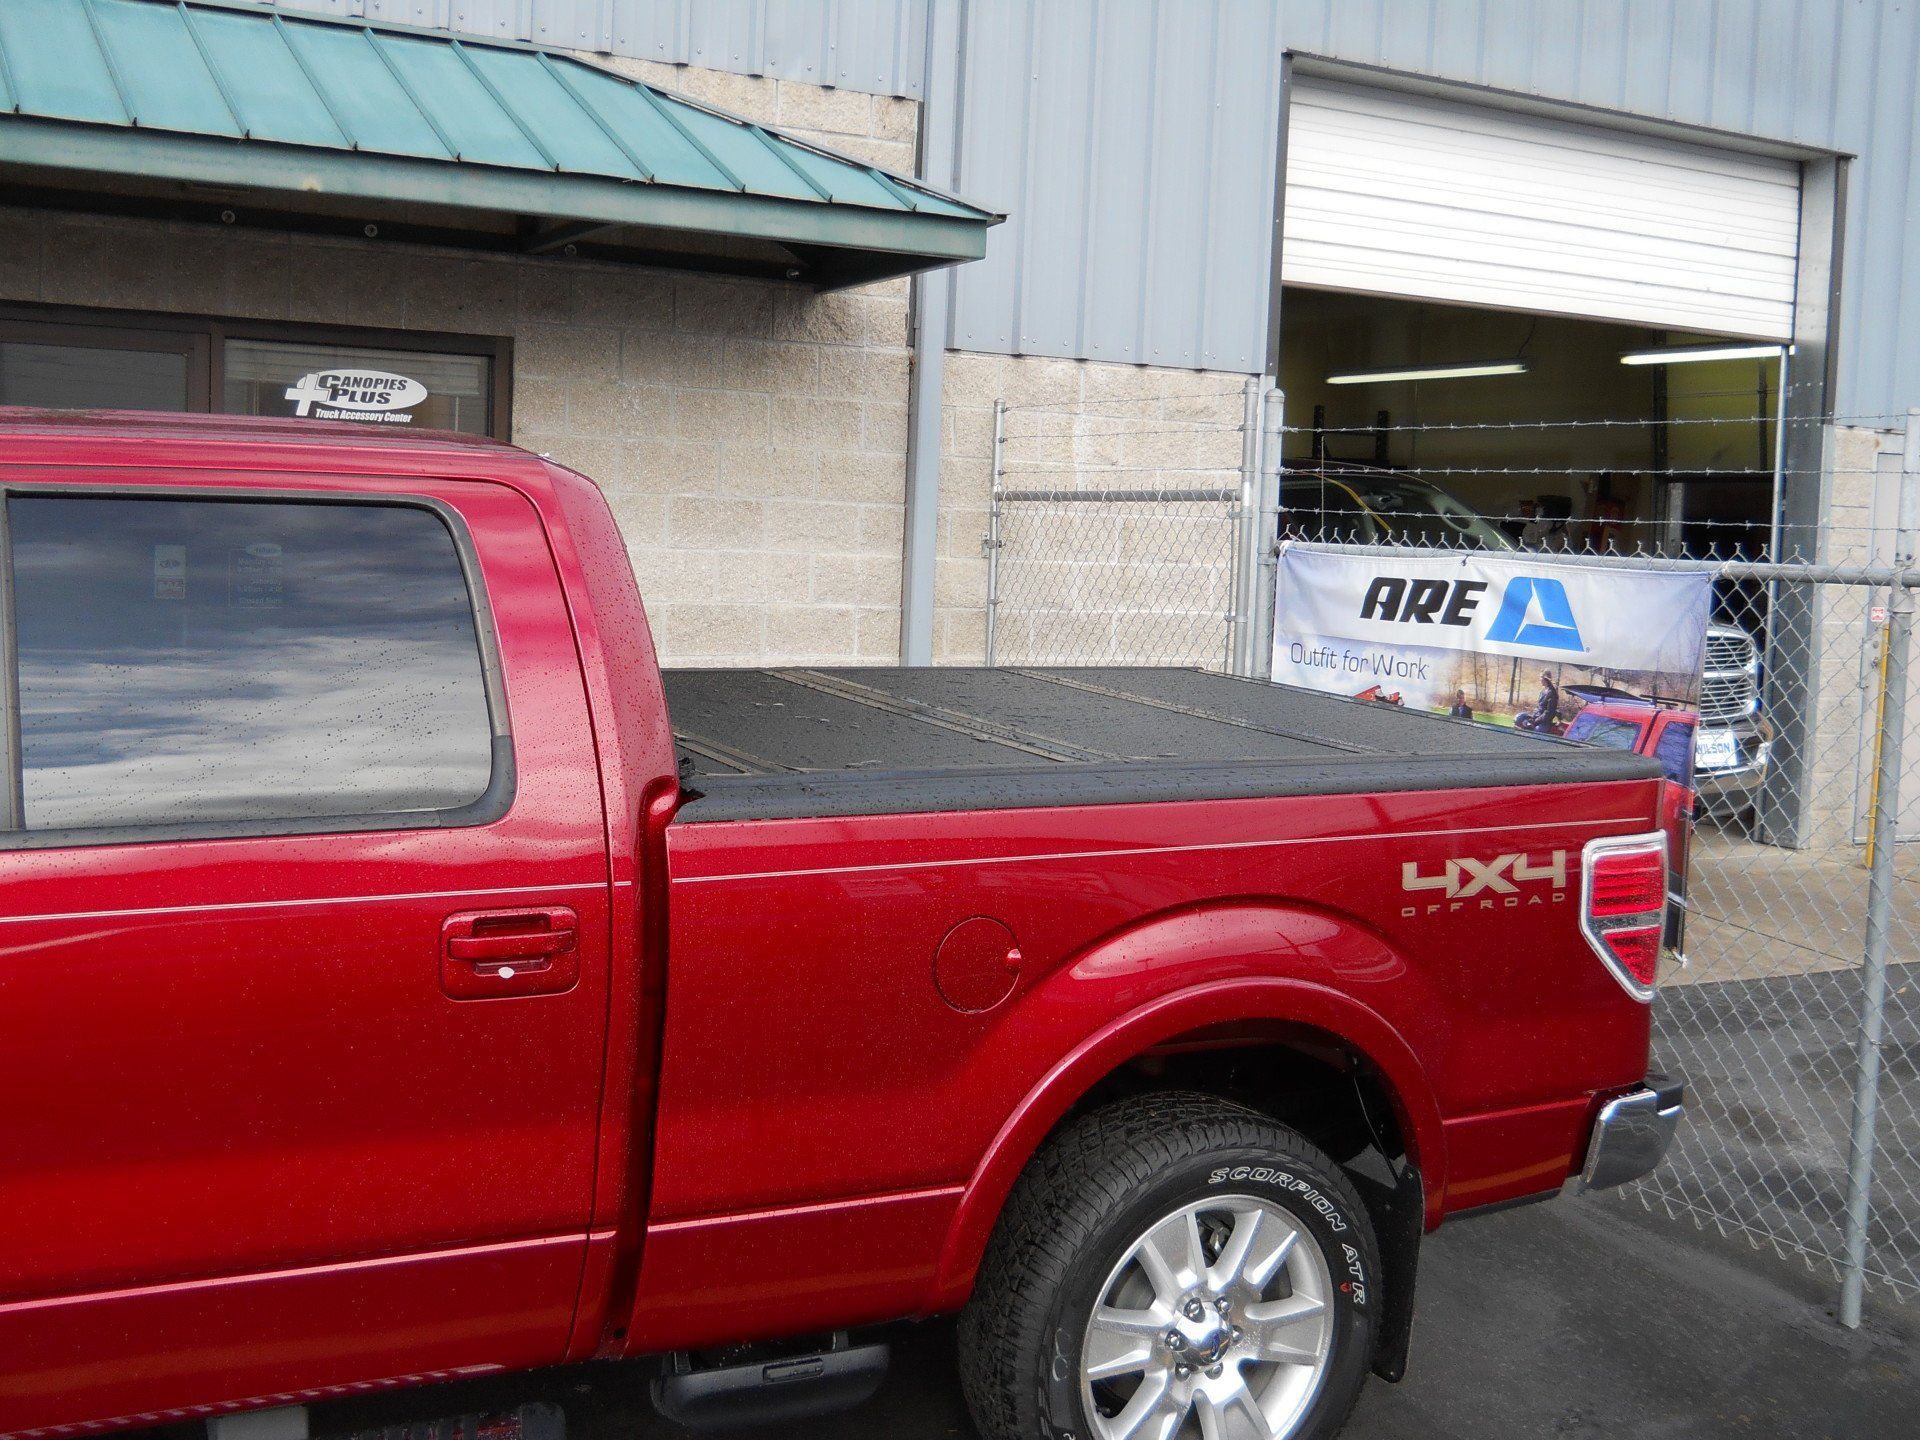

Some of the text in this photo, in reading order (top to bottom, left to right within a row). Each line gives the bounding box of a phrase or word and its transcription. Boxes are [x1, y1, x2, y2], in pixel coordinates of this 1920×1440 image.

[319, 375, 407, 390] CANOPIES
[329, 386, 391, 404] PLUS
[316, 409, 412, 422] Truck Accessory Center
[1360, 576, 1488, 627] ARE
[1291, 642, 1429, 680] Outfit for Work
[1208, 1167, 1346, 1232] SCORPION
